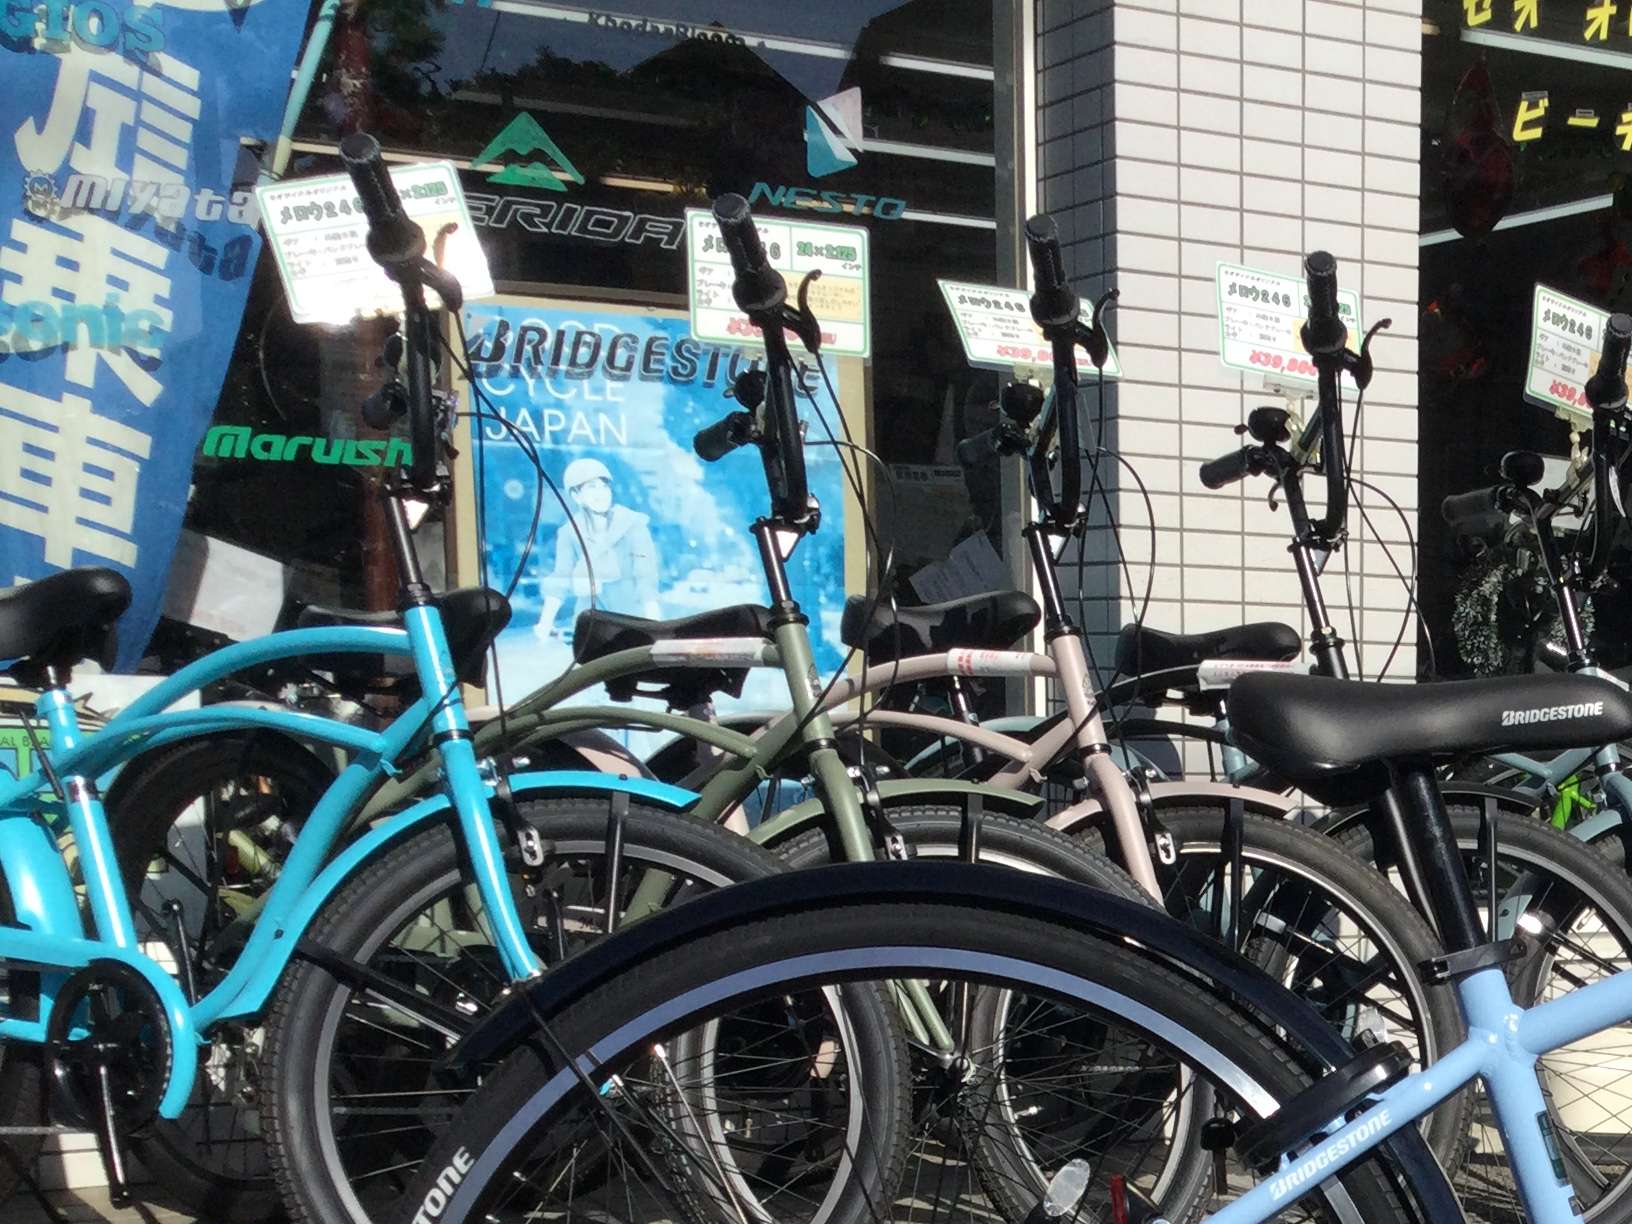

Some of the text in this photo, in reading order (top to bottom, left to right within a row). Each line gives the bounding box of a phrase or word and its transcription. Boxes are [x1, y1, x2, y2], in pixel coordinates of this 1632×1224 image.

[748, 182, 906, 219] NESTO
[465, 192, 686, 250] ERIDA
[485, 407, 628, 445] JAPAN
[1502, 701, 1604, 726] BRIDGESTONE
[1269, 1109, 1392, 1201] BRIDGESTONE
